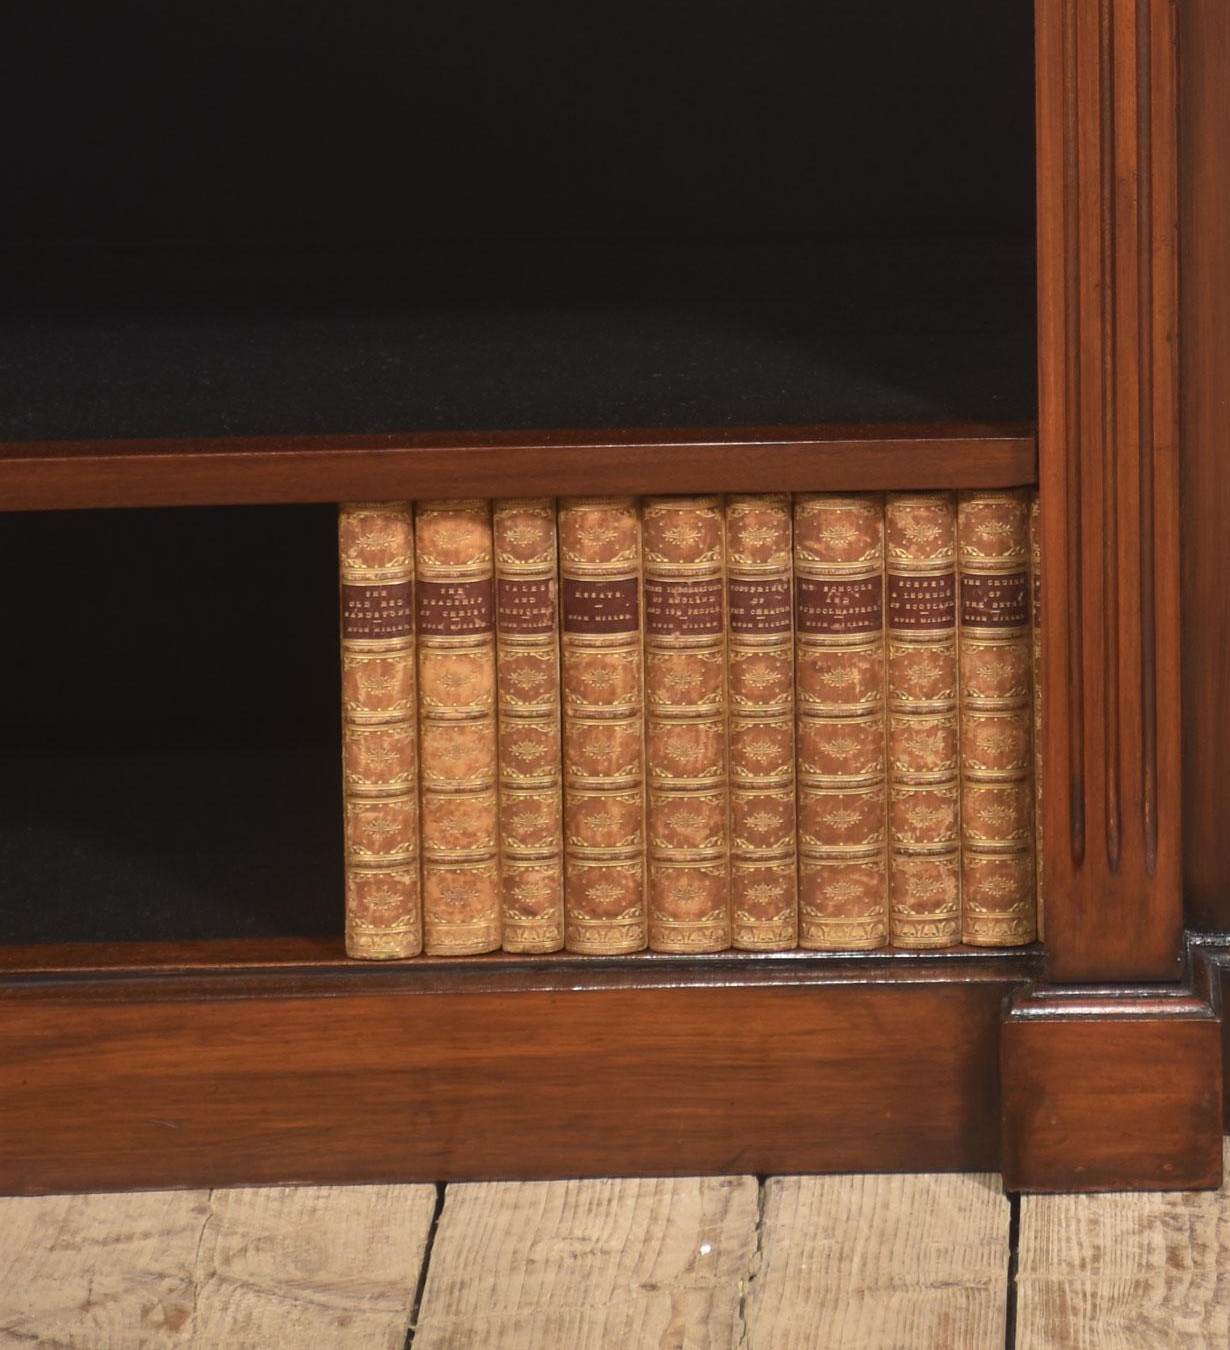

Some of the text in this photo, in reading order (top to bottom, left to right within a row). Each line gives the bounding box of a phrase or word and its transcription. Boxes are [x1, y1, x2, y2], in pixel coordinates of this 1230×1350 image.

[504, 584, 547, 592] TALES
[513, 596, 537, 604] AND
[965, 600, 984, 609] THE
